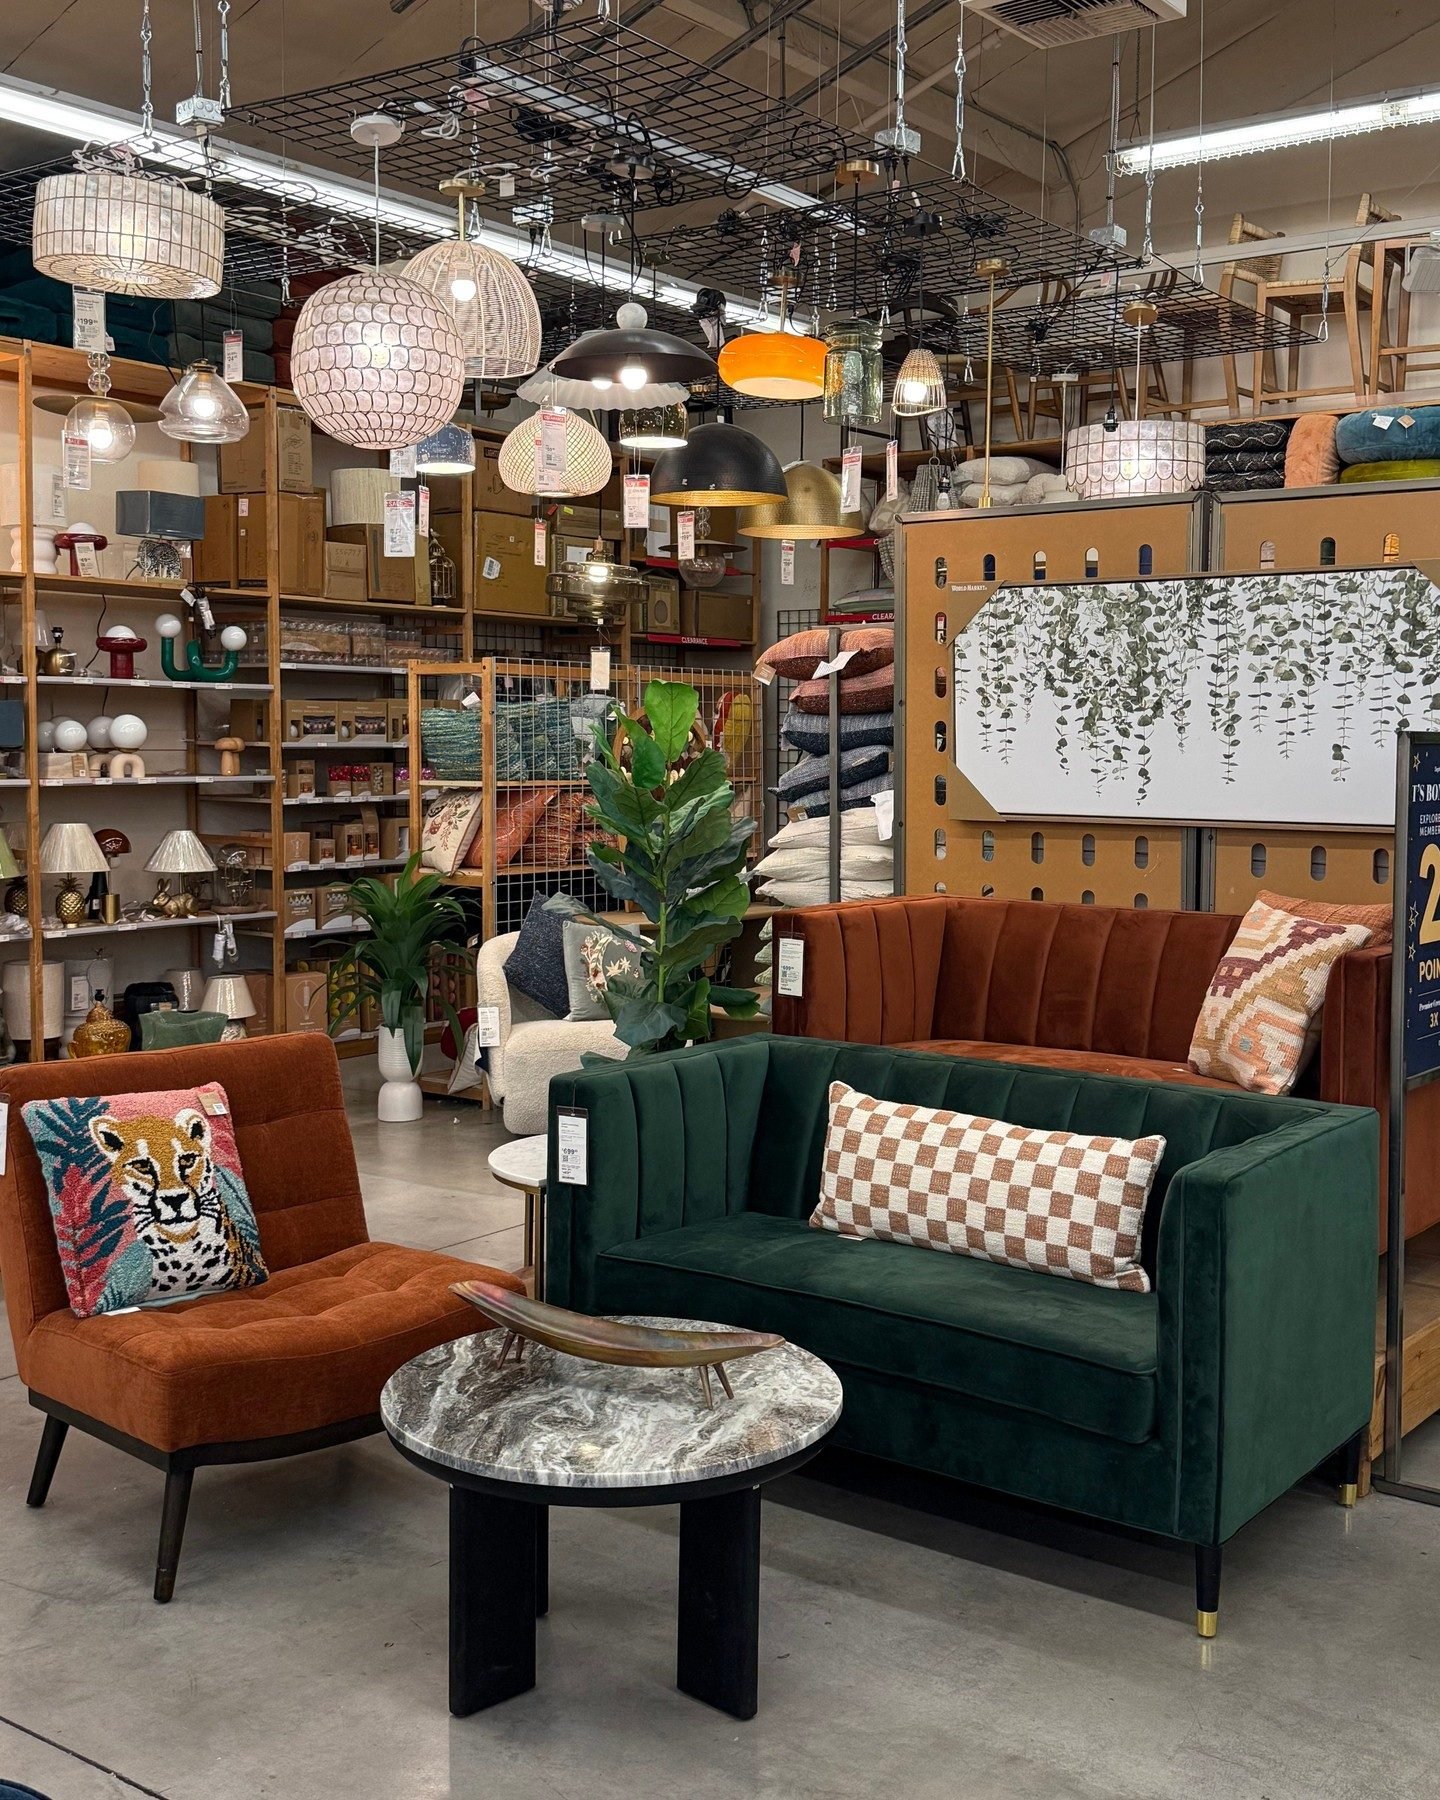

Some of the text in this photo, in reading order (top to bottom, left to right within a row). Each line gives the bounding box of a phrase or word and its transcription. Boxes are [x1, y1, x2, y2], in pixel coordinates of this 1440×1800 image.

[872, 613, 894, 621] CLEARA
[681, 636, 708, 645] CLEARANCE
[1430, 1011, 1439, 1028] 3X
